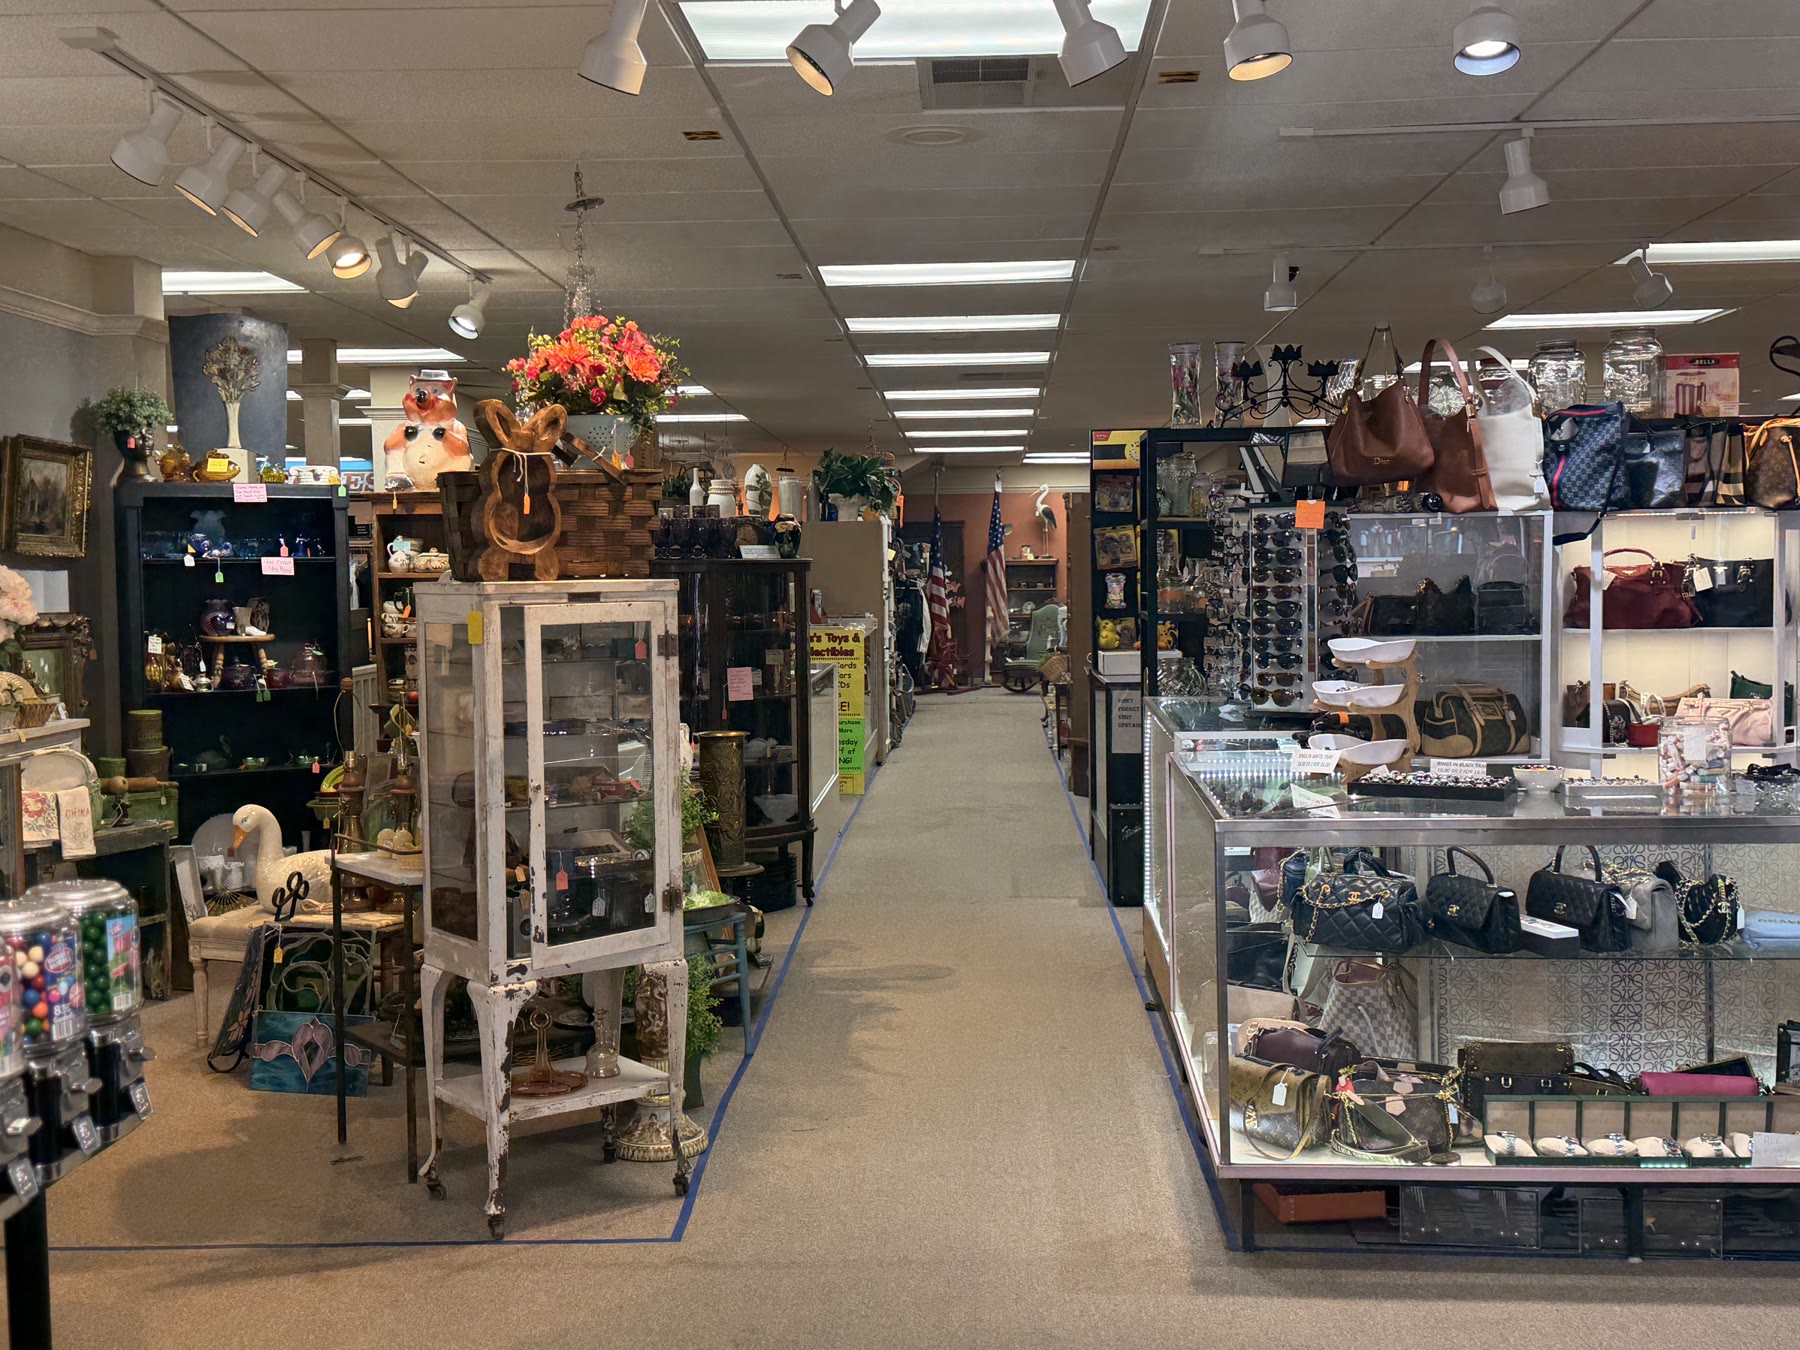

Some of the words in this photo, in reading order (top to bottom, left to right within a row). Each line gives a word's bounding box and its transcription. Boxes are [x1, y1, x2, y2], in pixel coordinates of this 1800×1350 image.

[825, 632, 849, 645] Toys
[852, 632, 861, 643] &
[838, 671, 852, 679] ars
[838, 757, 853, 765] NG!
